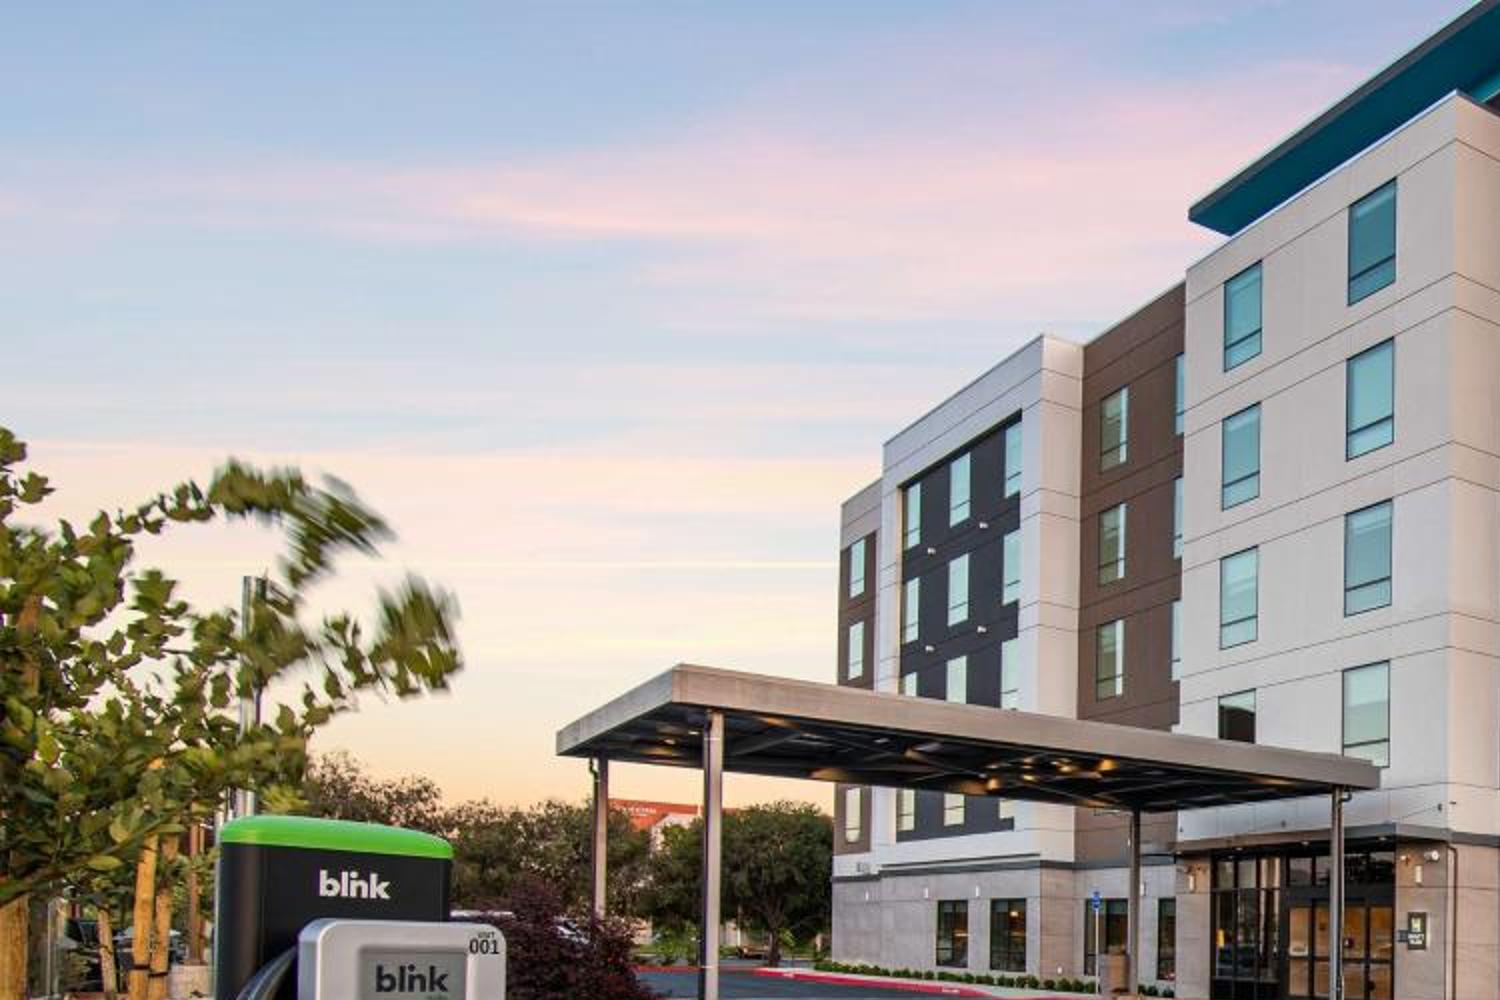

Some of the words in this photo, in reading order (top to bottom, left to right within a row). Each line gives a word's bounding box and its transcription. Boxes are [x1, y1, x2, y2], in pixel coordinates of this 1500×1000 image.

[319, 870, 390, 899] blink
[469, 938, 500, 955] 001
[376, 964, 449, 993] blink
